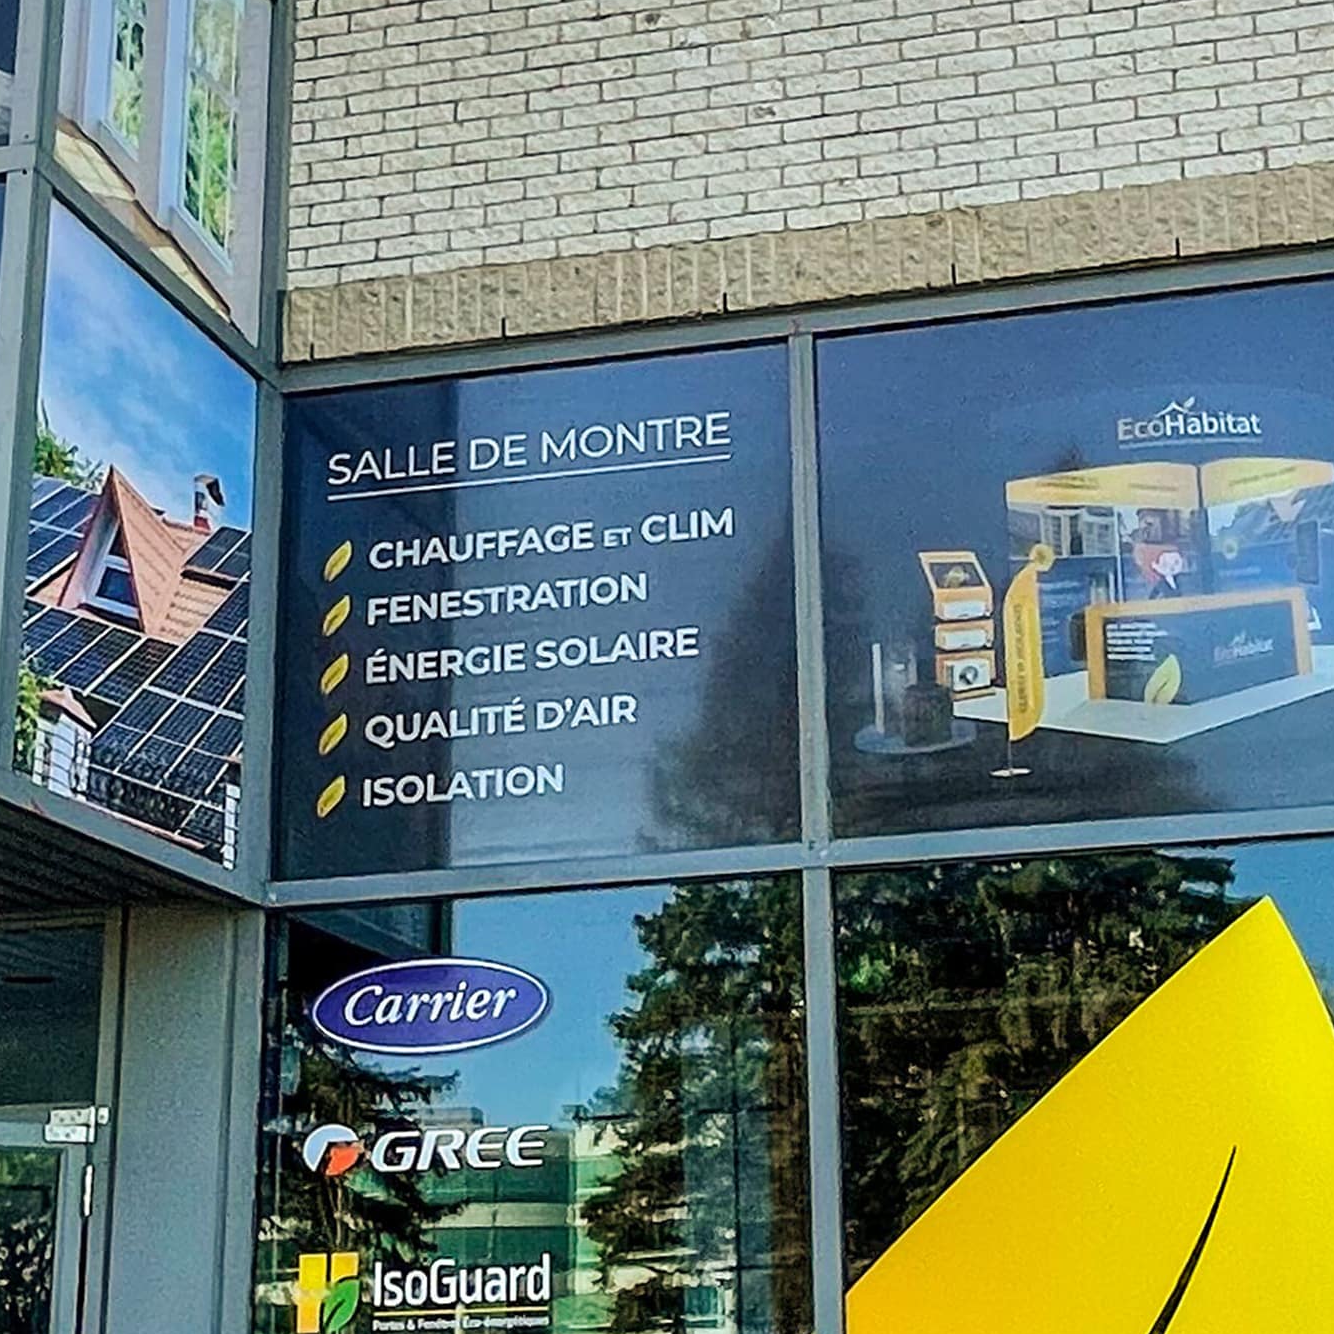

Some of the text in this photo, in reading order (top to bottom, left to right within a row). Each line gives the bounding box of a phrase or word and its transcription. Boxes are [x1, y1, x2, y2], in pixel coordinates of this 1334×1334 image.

[328, 412, 731, 485] SALLE DE MONTRE
[1117, 407, 1262, 443] EcoHabitat
[369, 508, 734, 569] CHAUFFAGE ET CLIM
[367, 573, 647, 626] FENESTRATION
[365, 627, 699, 685] ÉNERGIE SOLAIRE
[364, 694, 637, 748] QUALITÉ D'AIR
[362, 764, 564, 807] ISOLATION
[343, 982, 517, 1028] Carrier
[371, 1124, 550, 1172] GREE
[373, 1252, 551, 1307] IsoGuard
